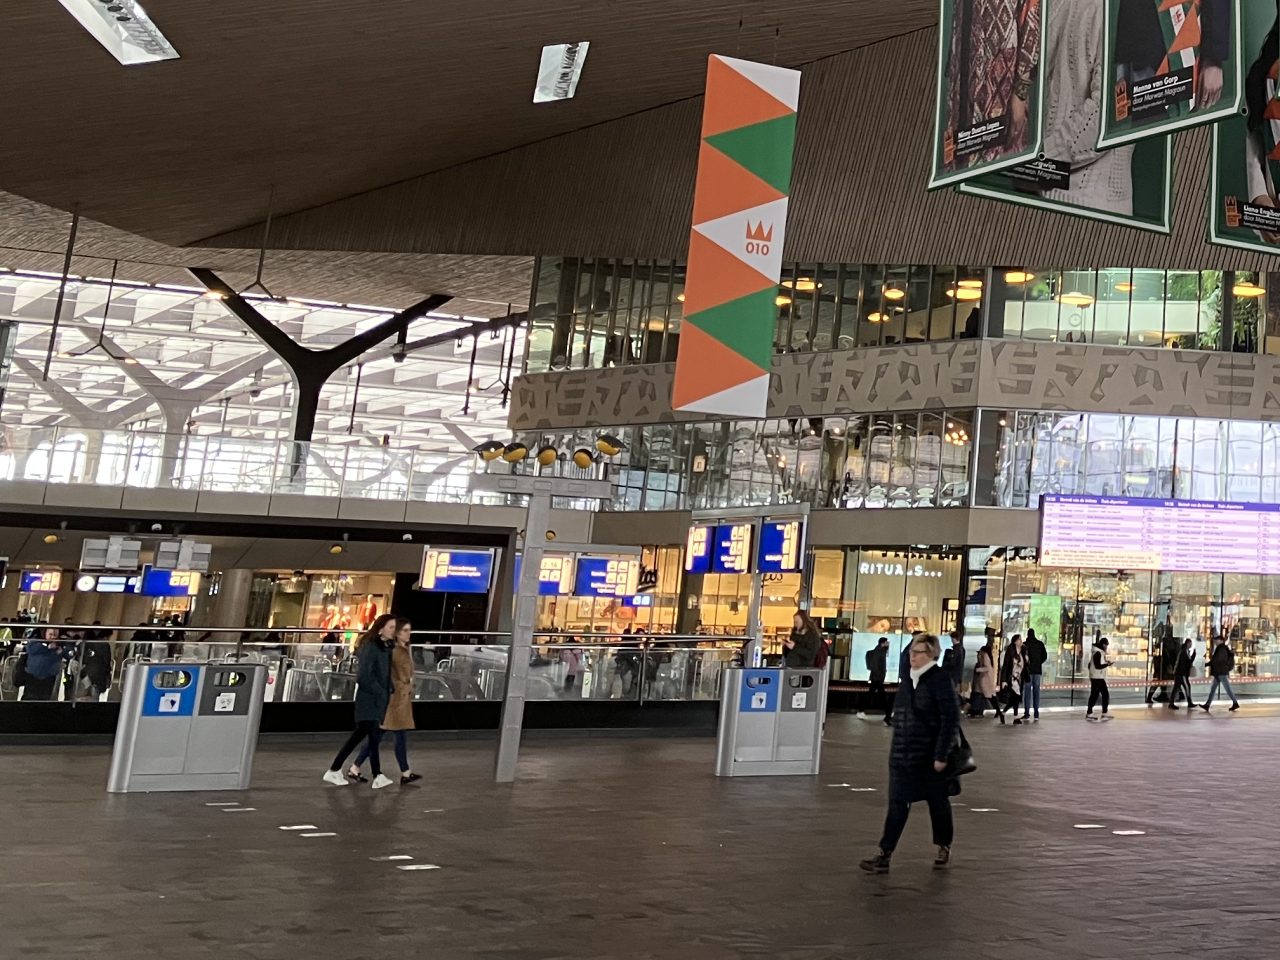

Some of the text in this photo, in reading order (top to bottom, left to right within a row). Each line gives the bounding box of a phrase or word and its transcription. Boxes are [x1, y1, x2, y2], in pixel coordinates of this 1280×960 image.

[1133, 75, 1179, 94] Menno van Gorp
[745, 242, 770, 256] 010
